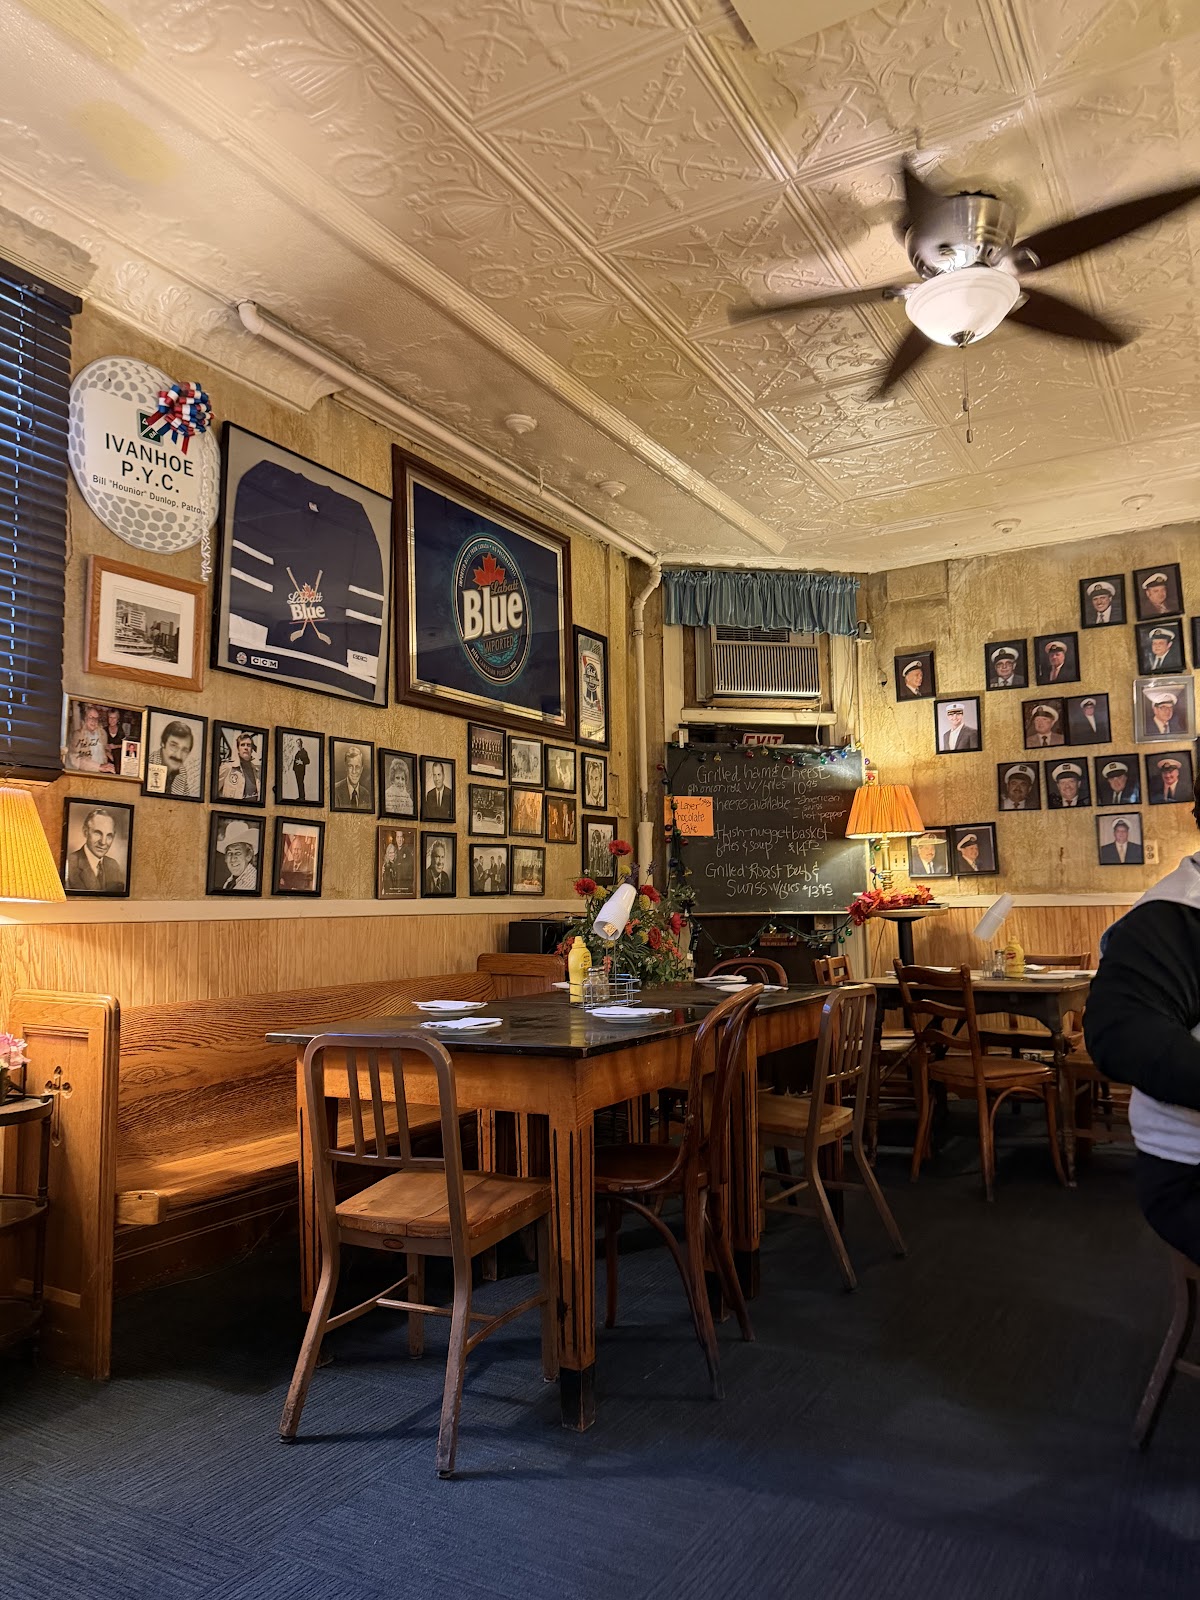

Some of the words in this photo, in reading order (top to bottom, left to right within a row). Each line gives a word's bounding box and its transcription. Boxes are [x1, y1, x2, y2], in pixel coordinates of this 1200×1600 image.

[105, 432, 194, 477] IVANHOE
[92, 475, 107, 486] Bill
[121, 460, 180, 494] P.Y.C.
[491, 580, 519, 595] Labatt
[287, 592, 324, 606] Labatt
[290, 603, 326, 621] Blue
[462, 586, 523, 641] Blue
[483, 635, 514, 655] IMPORTED
[252, 656, 278, 669] CCM
[697, 766, 741, 784] Grilled
[801, 811, 816, 820] hot
[706, 862, 745, 878] Grilled
[749, 862, 781, 880] Roast
[726, 879, 769, 898] Swiss
